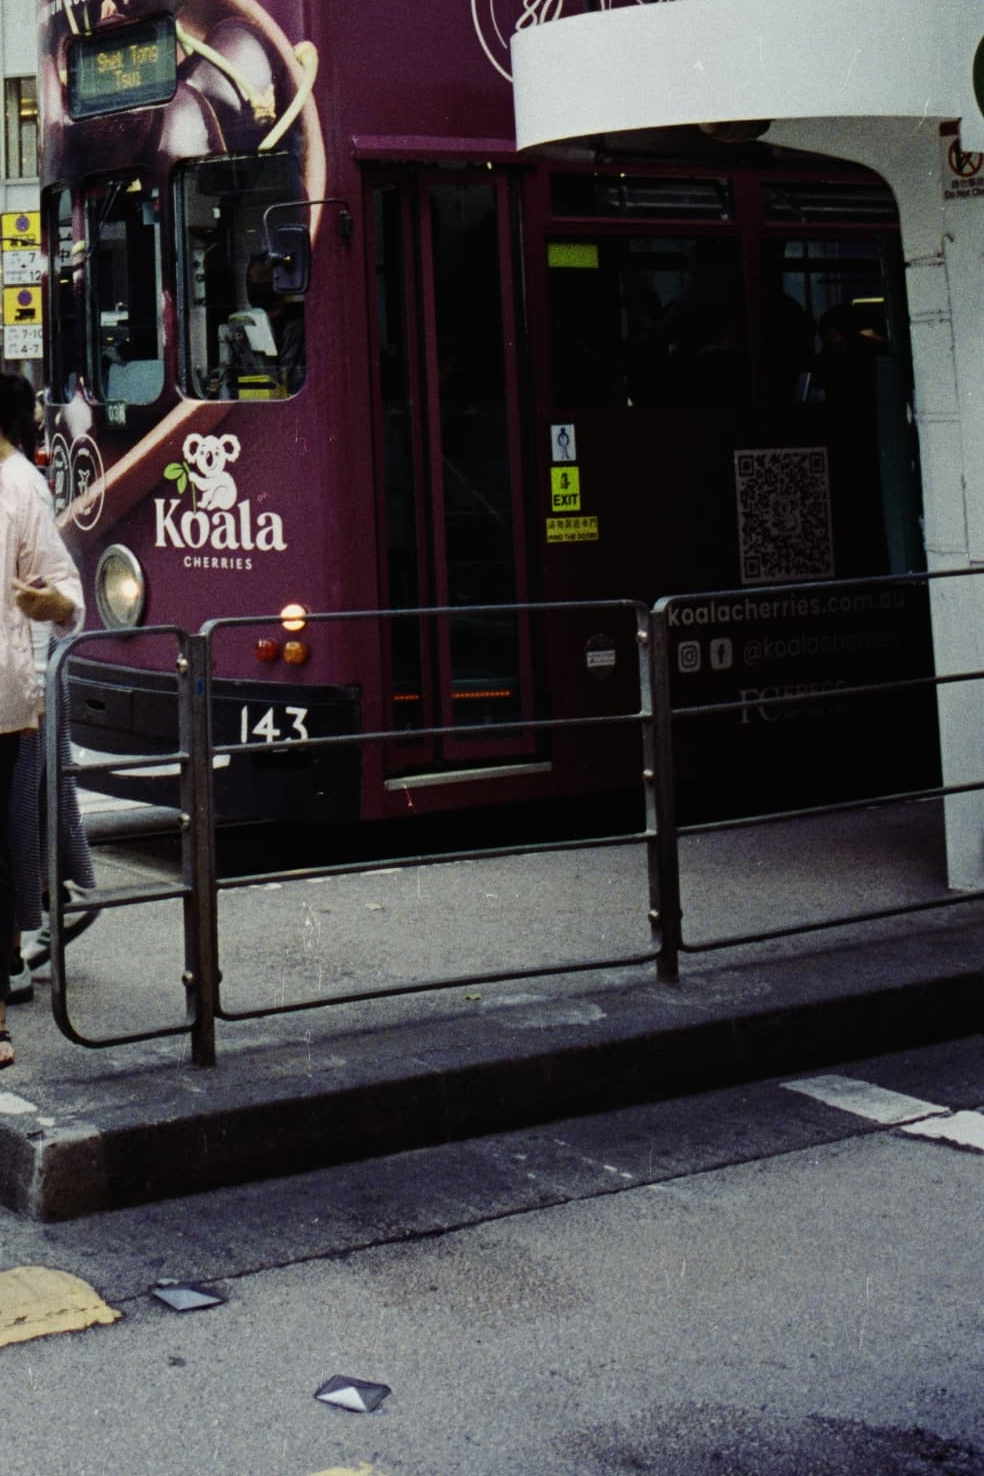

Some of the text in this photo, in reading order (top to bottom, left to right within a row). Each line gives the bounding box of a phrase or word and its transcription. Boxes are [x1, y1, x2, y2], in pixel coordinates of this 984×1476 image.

[553, 493, 578, 506] EXIT
[154, 498, 287, 551] Koala
[184, 555, 253, 571] CHERRIES
[667, 590, 904, 626] koalacherries.com.au
[241, 705, 308, 745] 143
